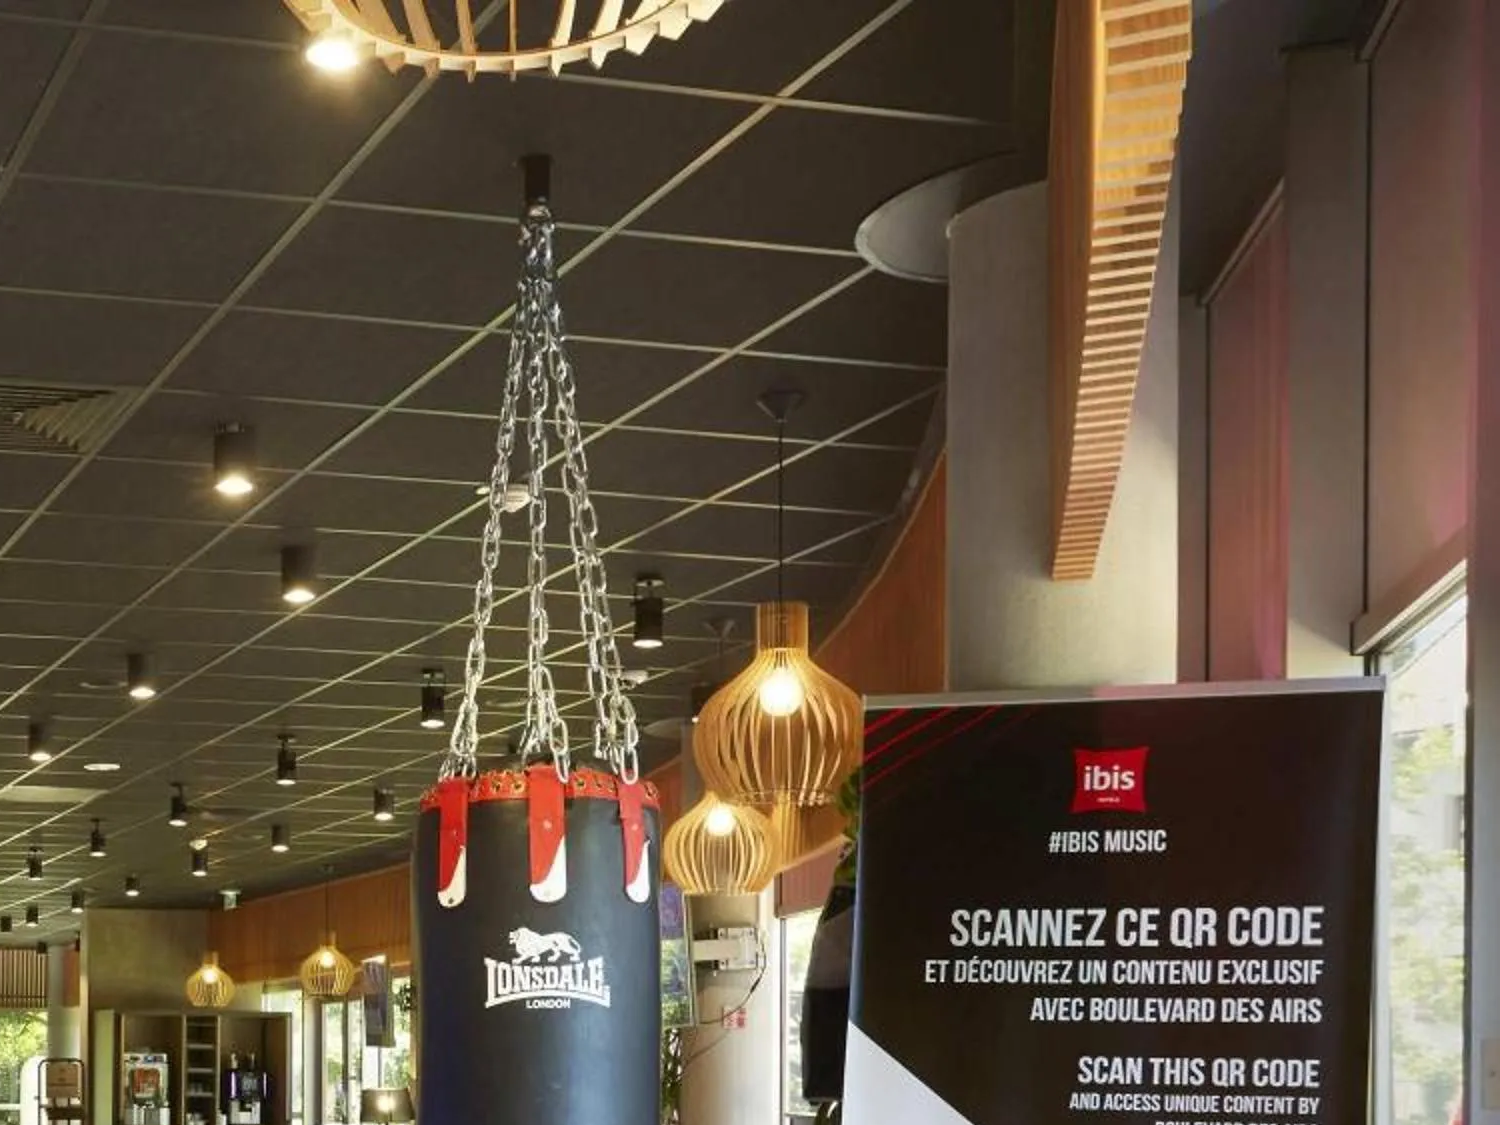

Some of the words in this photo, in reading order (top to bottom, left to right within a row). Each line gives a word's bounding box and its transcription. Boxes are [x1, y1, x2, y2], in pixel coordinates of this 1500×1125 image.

[1083, 764, 1135, 791] ibis
[1048, 830, 1100, 853] #IBIS
[1103, 829, 1167, 853] MUSIC
[950, 908, 1107, 947] SCANNEZ
[1115, 907, 1161, 947] CE
[1169, 907, 1217, 949] QR
[1227, 905, 1325, 947] CODE
[484, 955, 611, 1008] LONSDALE
[925, 959, 950, 983] ET
[953, 955, 1073, 984] DÉCOUVREZ
[1078, 959, 1107, 985] UN
[1112, 959, 1213, 985] CONTENU
[1217, 959, 1325, 985] EXCLUSIF
[1029, 997, 1085, 1022] AVEC
[1089, 997, 1216, 1023] BOULEVARD
[1221, 997, 1265, 1023] DES
[1268, 997, 1323, 1024] AIRS
[1077, 1056, 1143, 1085] SCAN
[1148, 1057, 1206, 1086] THIS
[1211, 1057, 1246, 1088] QR
[1252, 1058, 1321, 1088] CODE
[1069, 1092, 1100, 1111] AND
[1103, 1092, 1161, 1113] ACCESS
[1163, 1094, 1221, 1114] UNIQUE
[1223, 1094, 1296, 1115] CONTENT
[1297, 1096, 1321, 1115] BY
